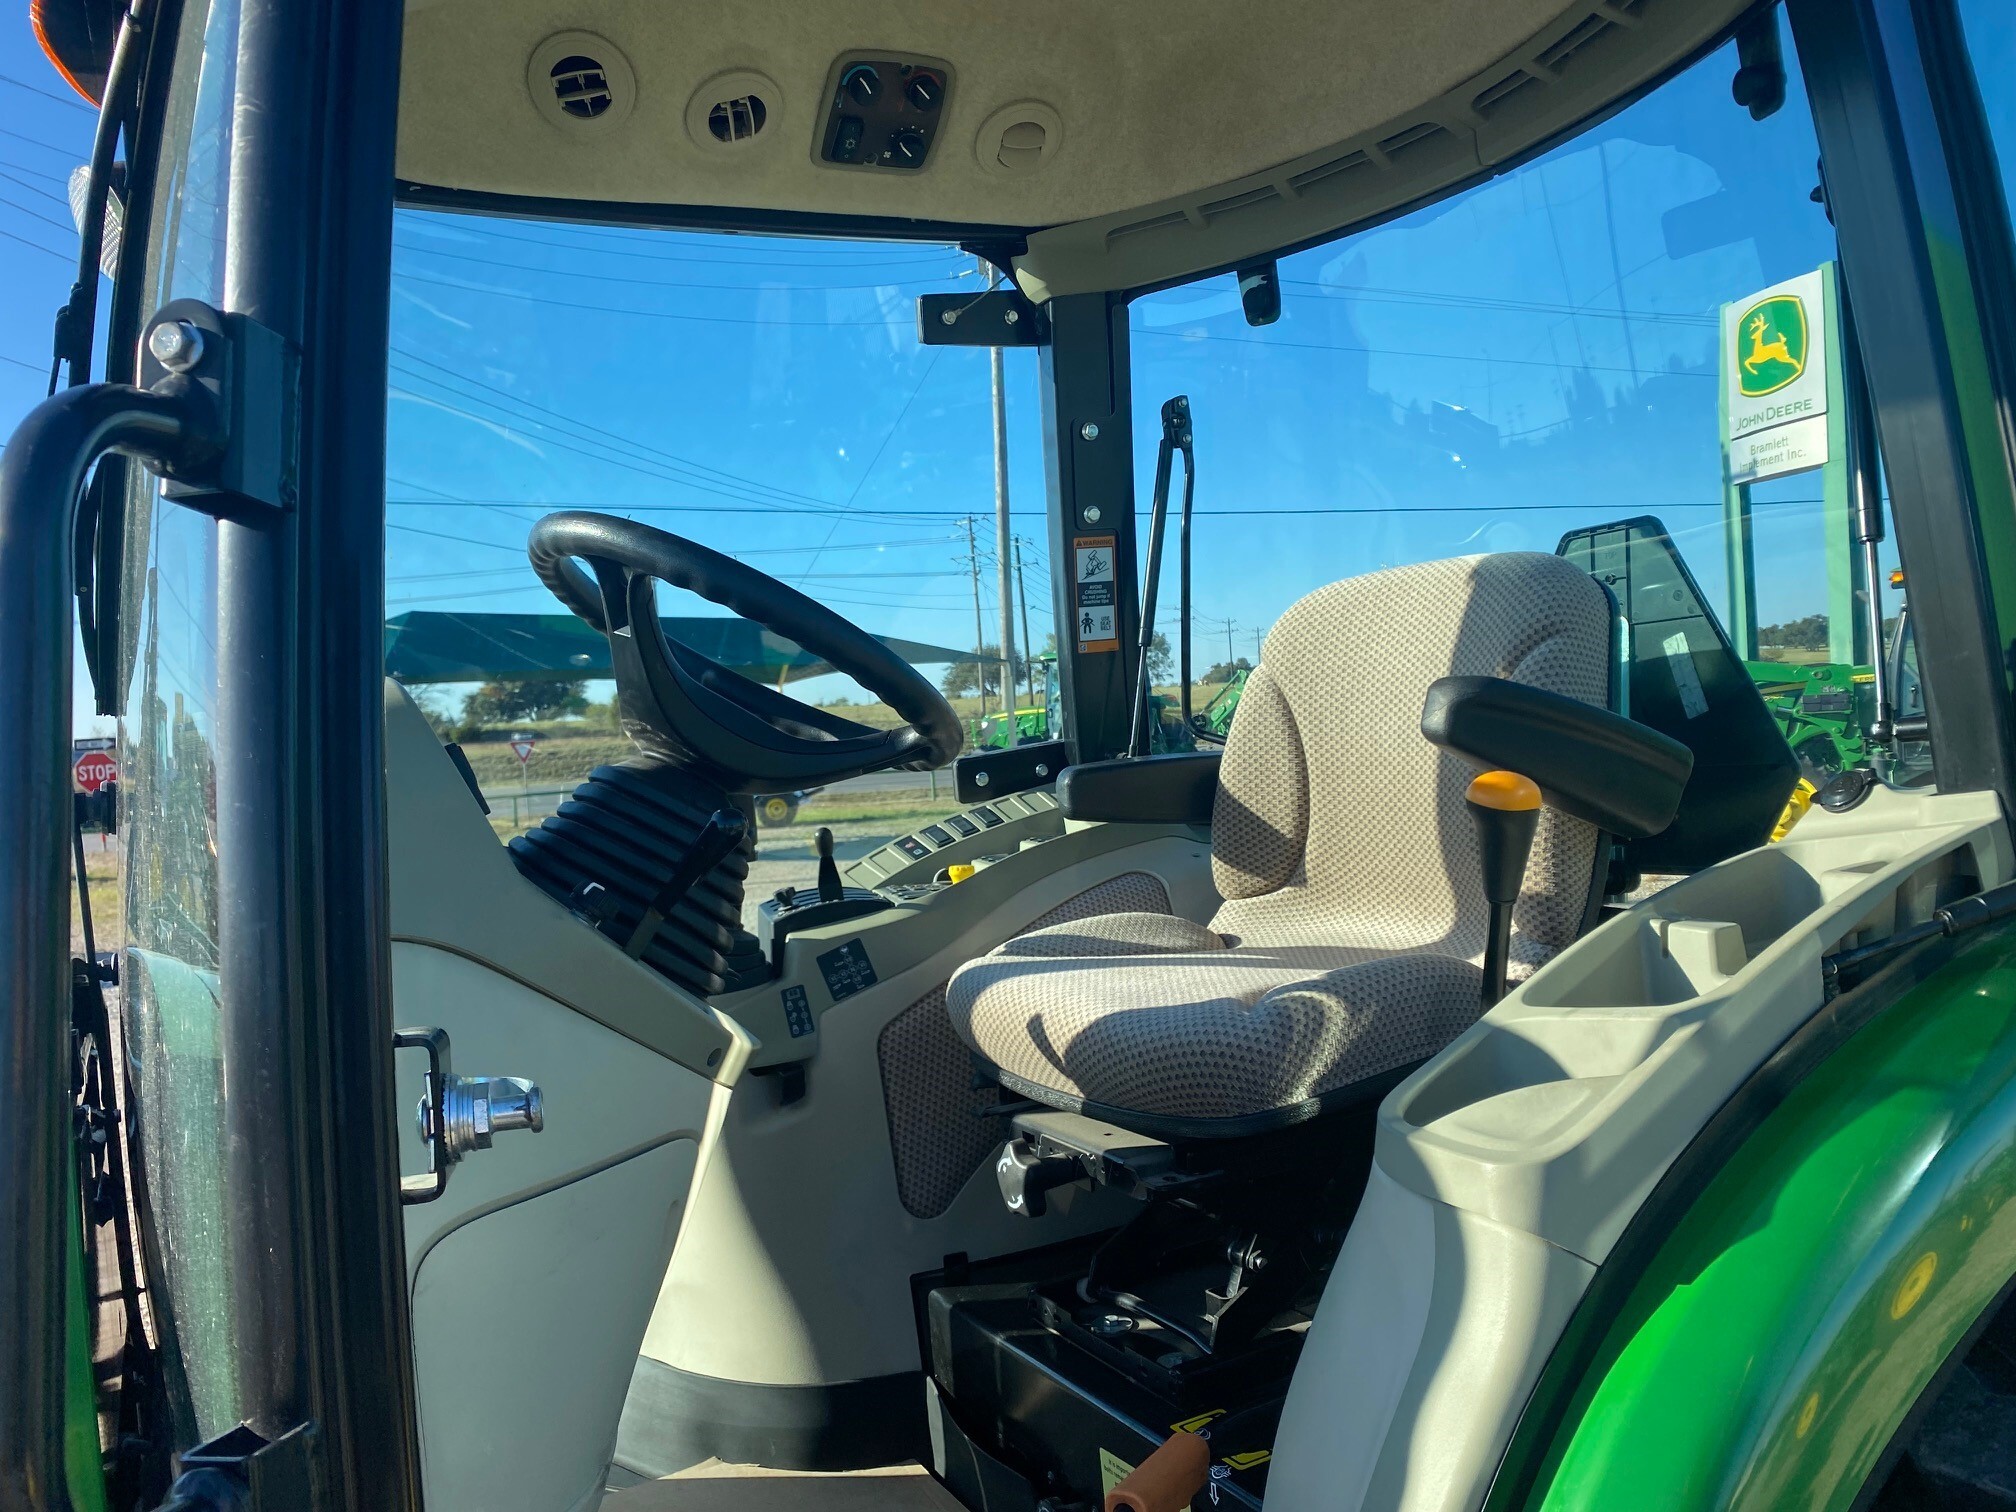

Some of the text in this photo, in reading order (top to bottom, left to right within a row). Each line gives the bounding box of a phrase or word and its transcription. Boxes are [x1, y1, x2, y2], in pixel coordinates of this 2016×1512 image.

[1736, 398, 1813, 431] JOHN DEERE
[1750, 435, 1790, 456] Bramlett
[1739, 448, 1807, 474] Implement Inc.
[78, 764, 117, 781] STOP
